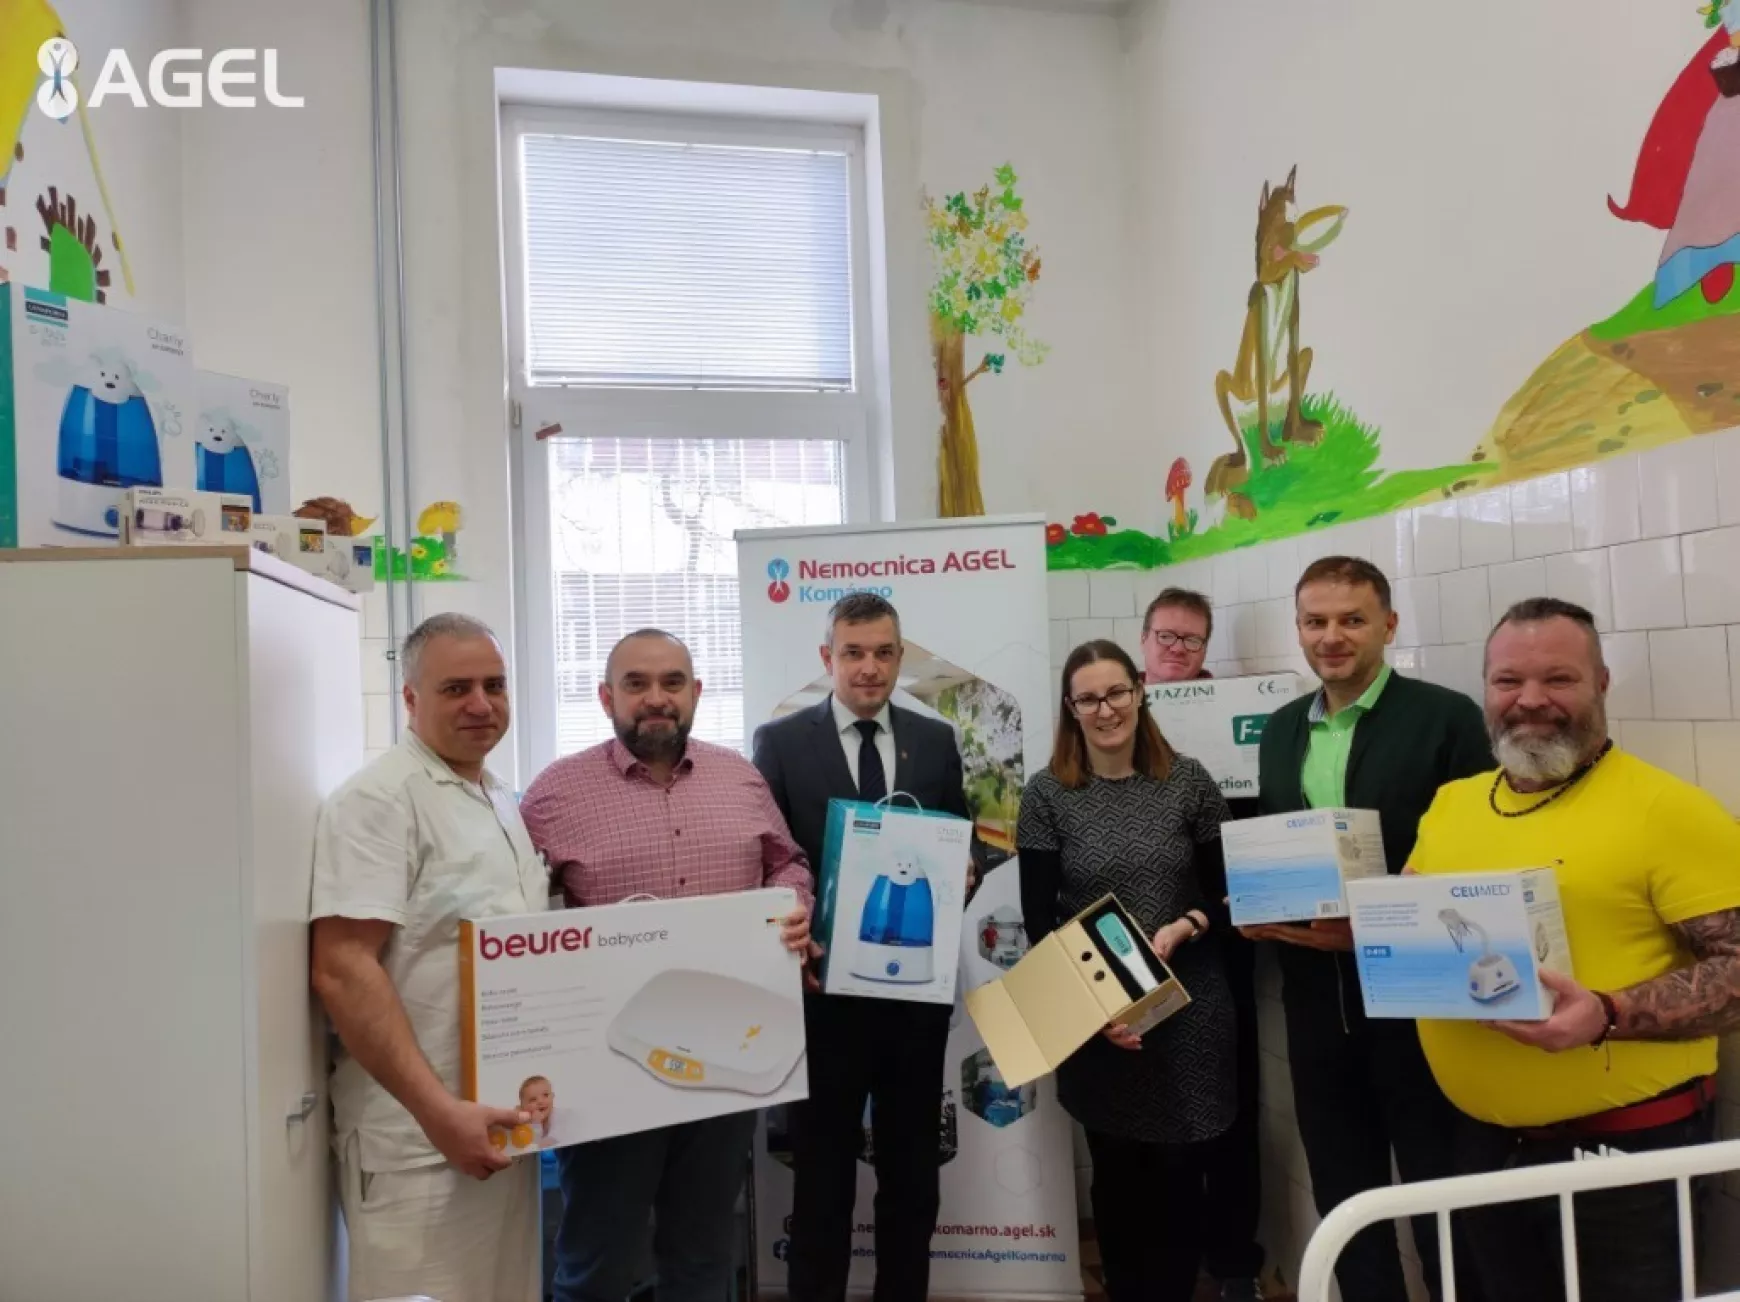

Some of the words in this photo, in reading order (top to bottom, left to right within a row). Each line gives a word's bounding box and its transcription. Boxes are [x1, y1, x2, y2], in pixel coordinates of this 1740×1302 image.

[798, 553, 936, 580] Nemocnica
[941, 547, 1017, 574] AGEL
[1154, 683, 1216, 701] FAZZINI
[1239, 719, 1264, 742] F-
[1217, 775, 1254, 790] ction
[1450, 884, 1512, 899] CELIMED
[478, 926, 593, 961] beurer
[597, 928, 669, 948] babycare
